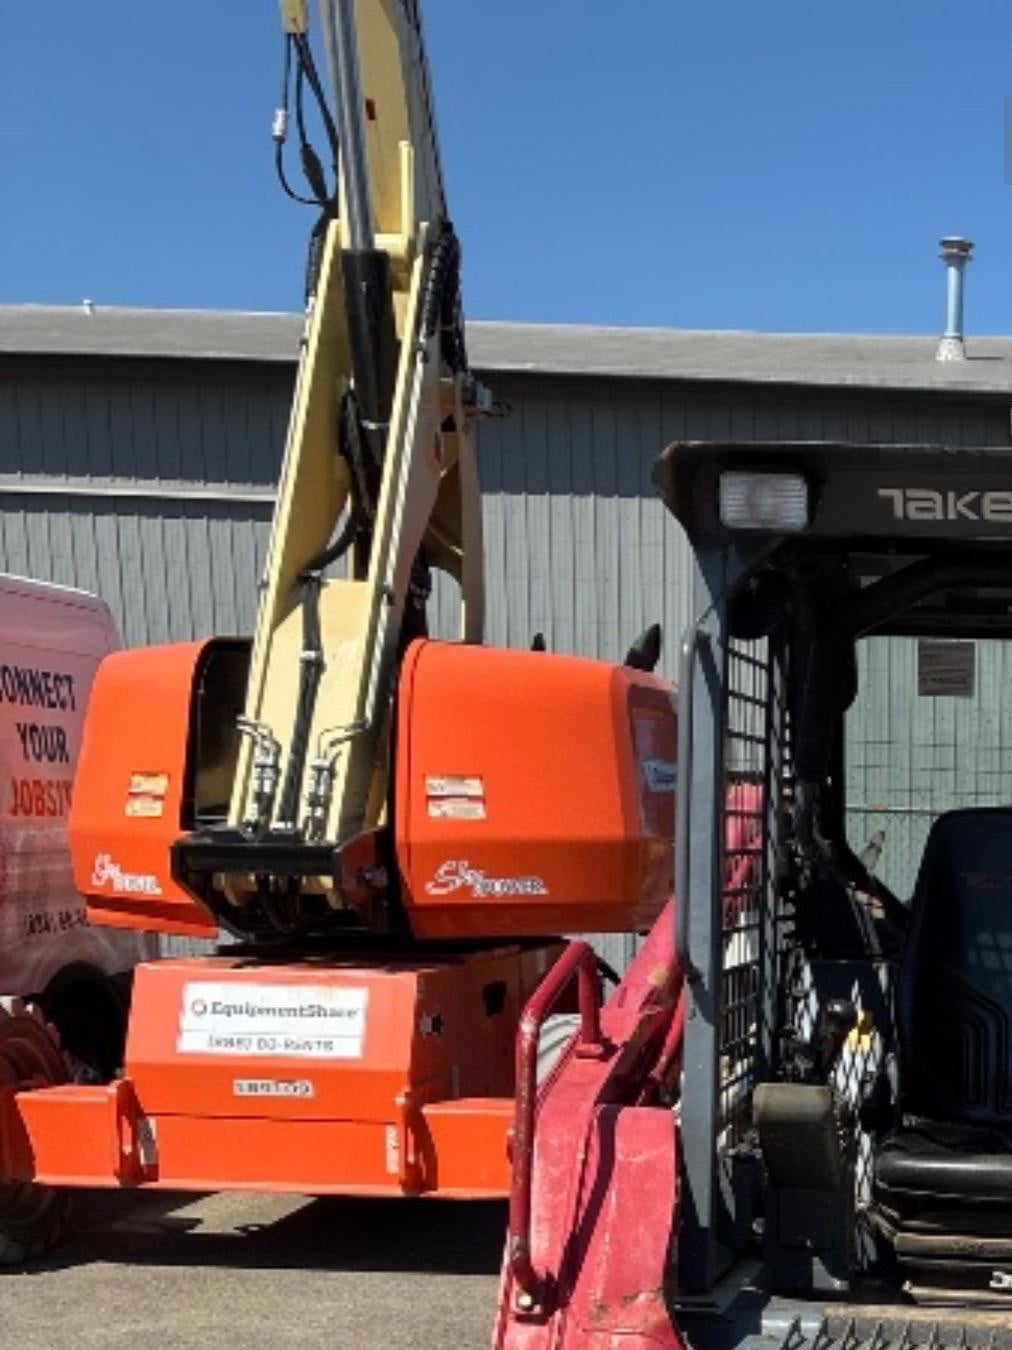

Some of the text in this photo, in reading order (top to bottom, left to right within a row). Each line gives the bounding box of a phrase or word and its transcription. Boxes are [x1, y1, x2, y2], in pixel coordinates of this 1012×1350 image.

[0, 665, 76, 711] ONNECT
[15, 722, 70, 763] YOUR
[210, 1000, 358, 1019] EquipmentShare
